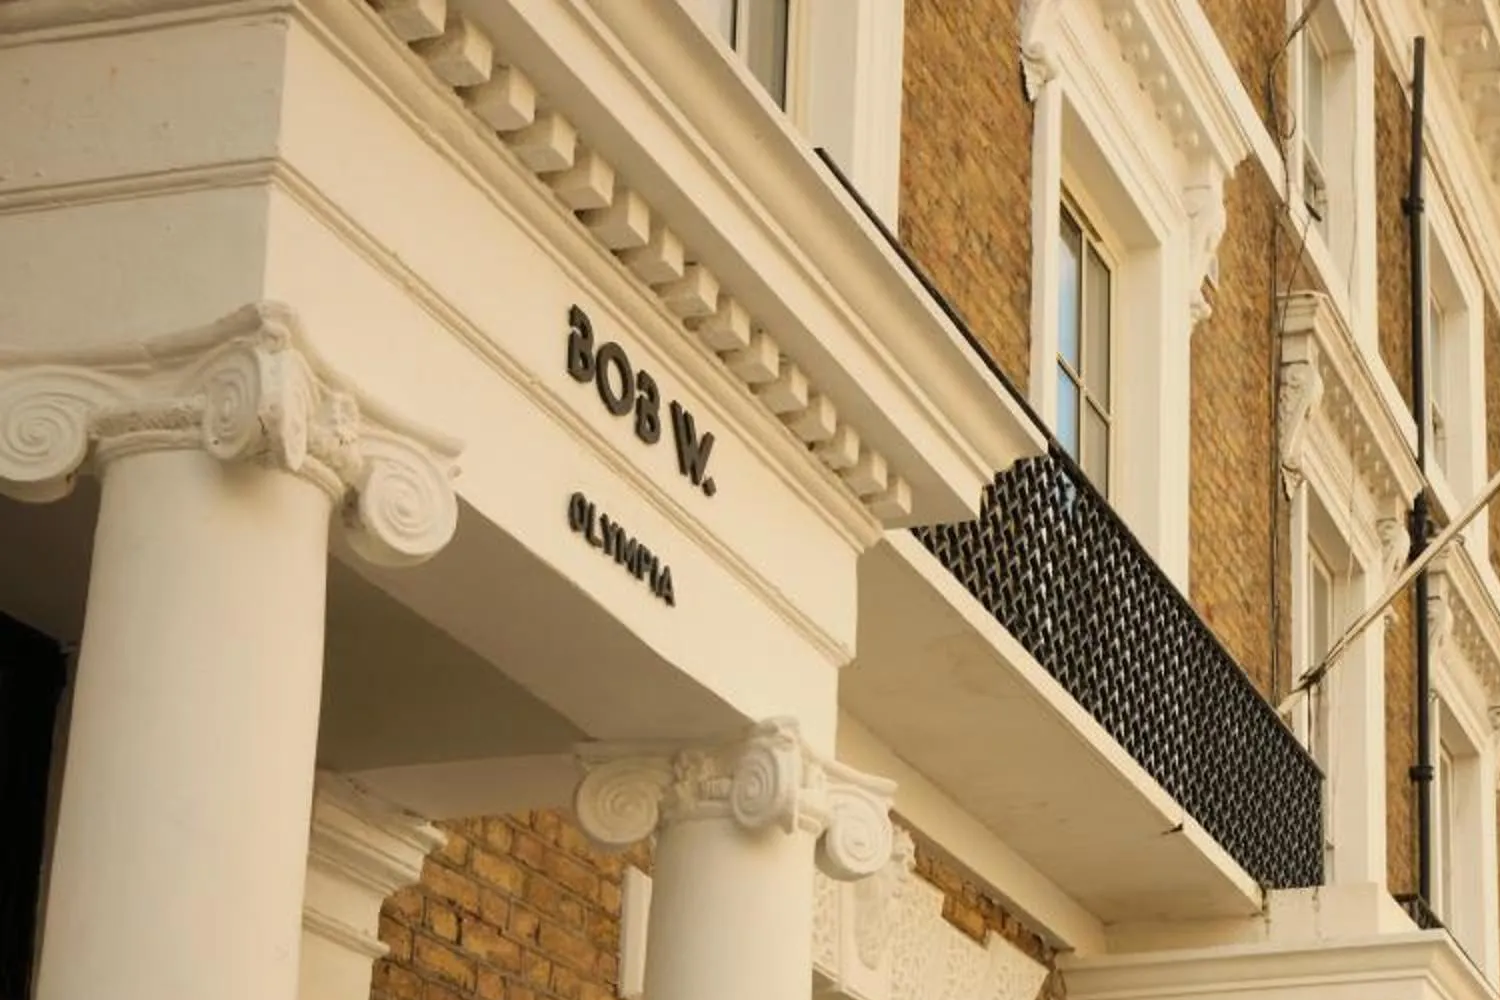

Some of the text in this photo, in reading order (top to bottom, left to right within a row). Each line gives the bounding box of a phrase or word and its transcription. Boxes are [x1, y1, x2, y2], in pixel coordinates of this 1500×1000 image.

[567, 303, 716, 497] BOB W.
[567, 492, 675, 607] OLYMPIA
